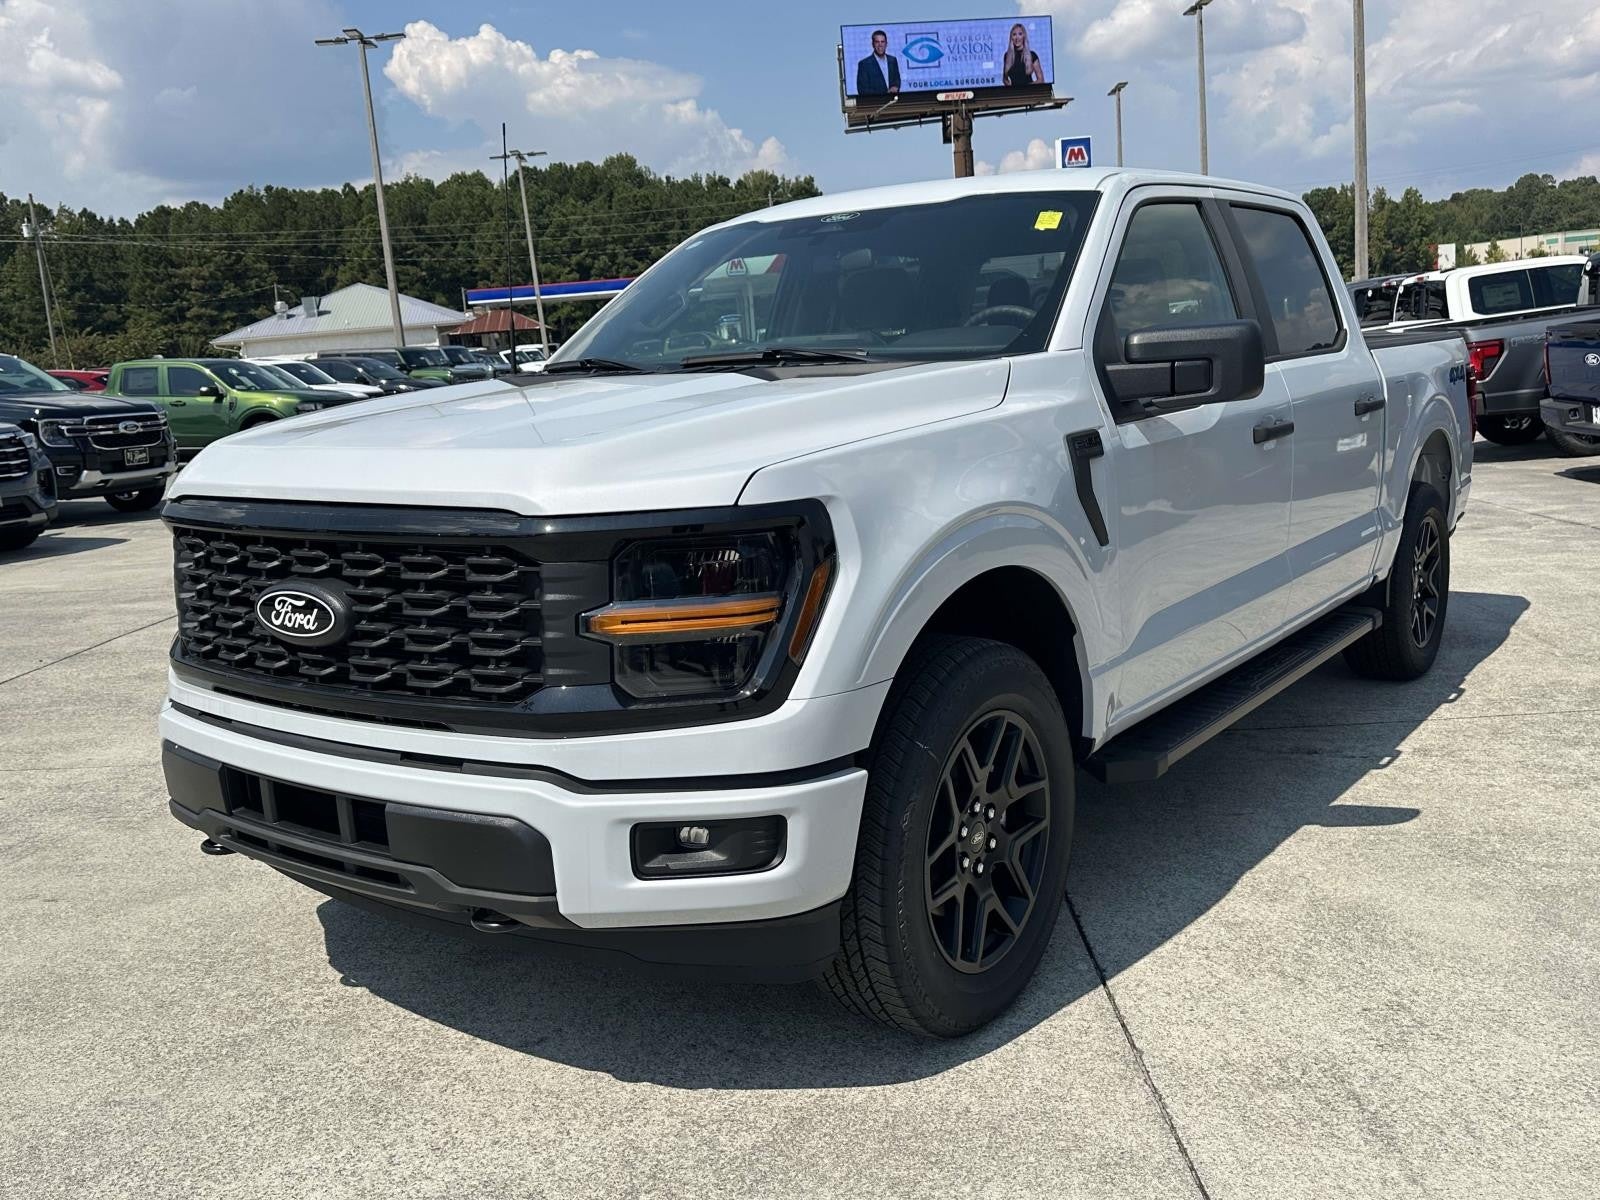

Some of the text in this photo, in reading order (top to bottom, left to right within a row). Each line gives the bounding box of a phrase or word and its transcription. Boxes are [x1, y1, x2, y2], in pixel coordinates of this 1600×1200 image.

[947, 41, 993, 54] VISION
[930, 79, 953, 87] LOCAL
[271, 596, 318, 631] Ford
